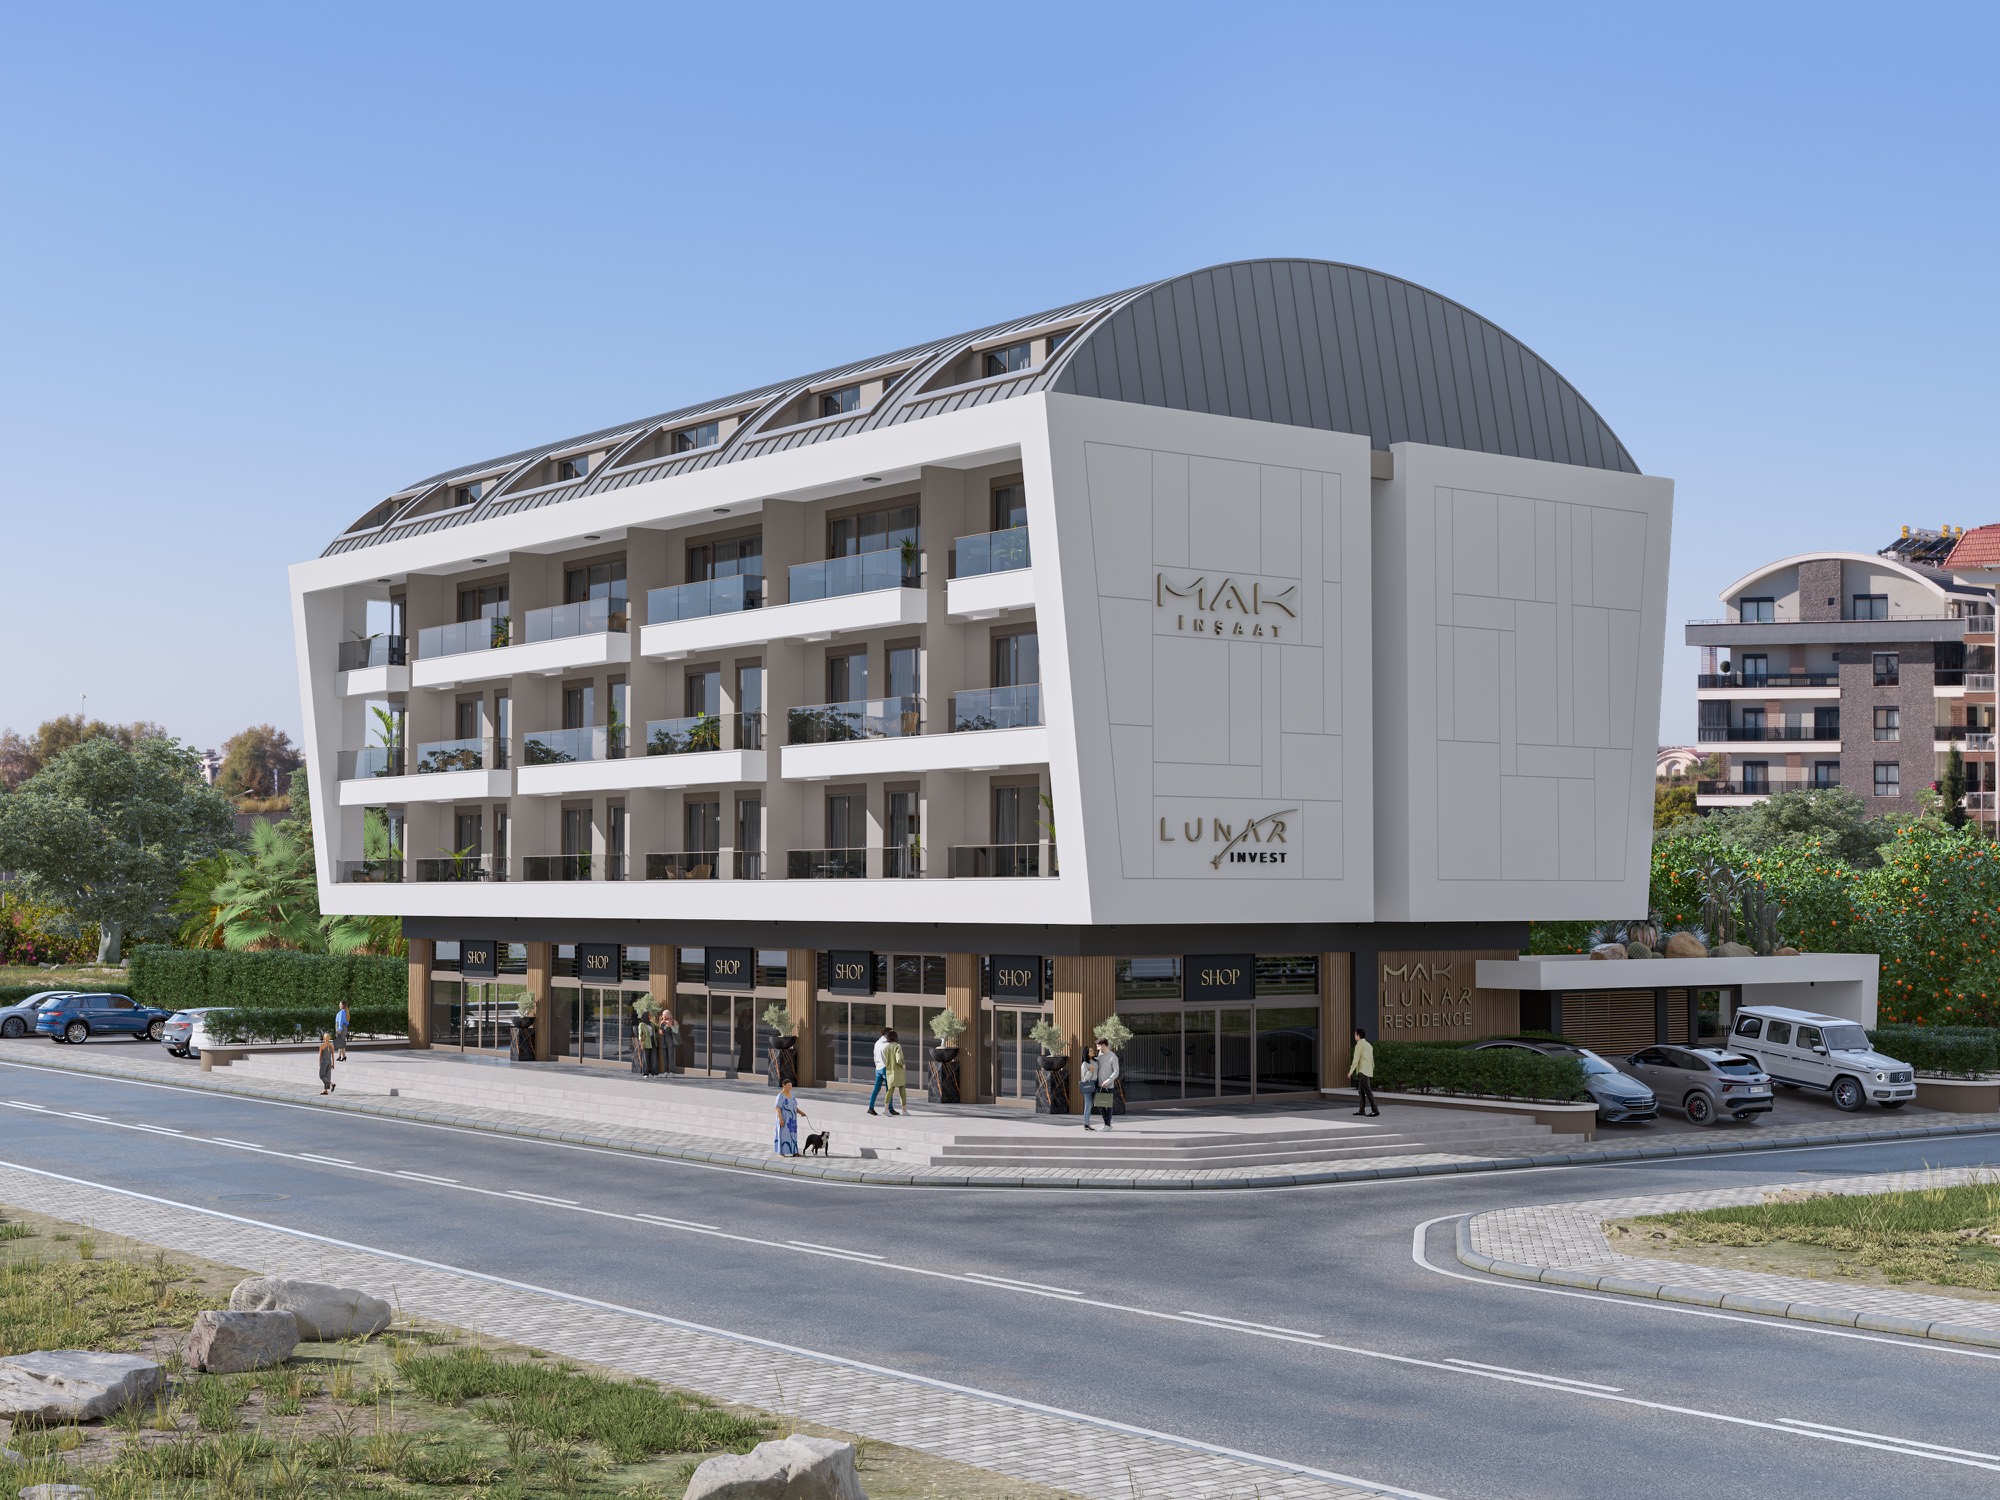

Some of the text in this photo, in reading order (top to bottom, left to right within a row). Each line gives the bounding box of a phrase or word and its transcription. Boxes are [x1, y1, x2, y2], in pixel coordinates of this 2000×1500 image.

[1156, 572, 1298, 618] MAK
[1160, 815, 1288, 843] LUNAR
[1229, 851, 1288, 864] INVEST
[467, 950, 487, 964] SHOP
[586, 954, 609, 969] SHOP
[715, 959, 741, 975] SHOP
[835, 963, 864, 980] SHOP
[1383, 962, 1453, 983] MAK
[998, 969, 1032, 987] SHOP
[1201, 968, 1240, 986] SHOP
[1384, 987, 1472, 1007] LUNAR
[1384, 1012, 1472, 1029] RESIDENCE
